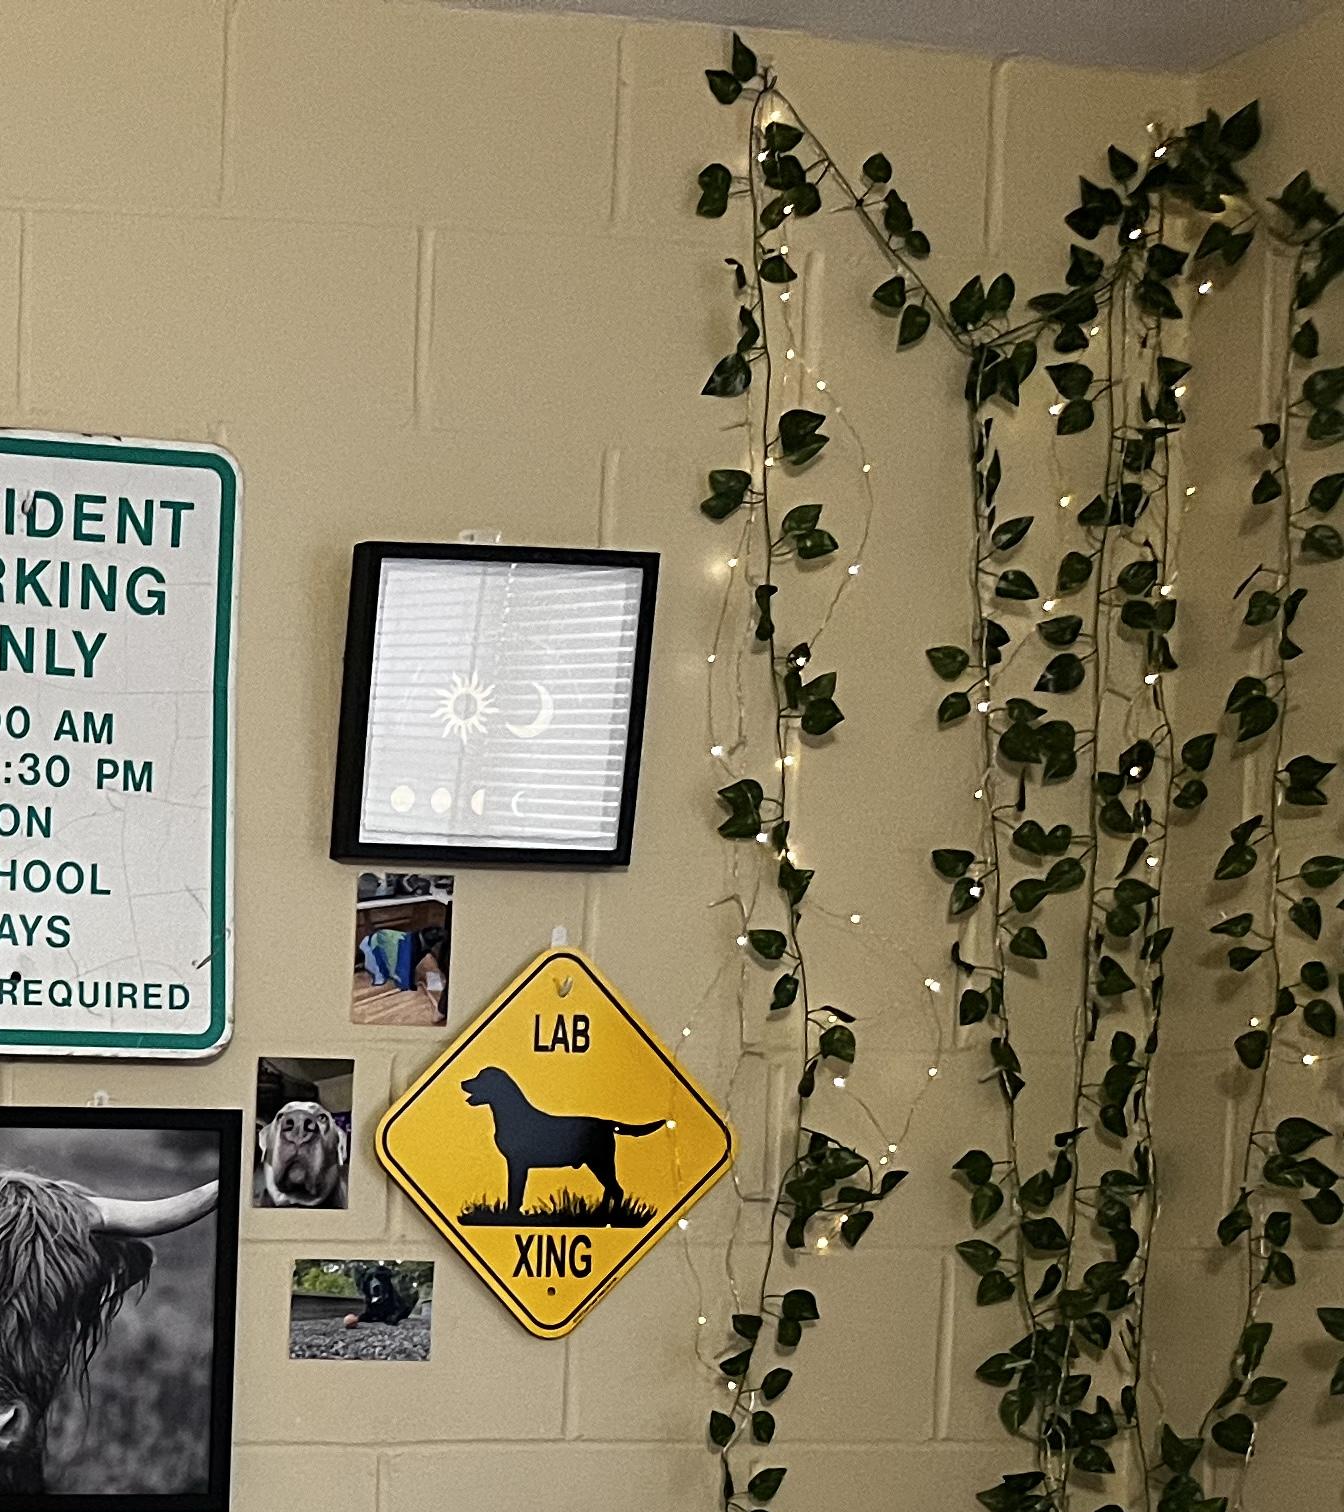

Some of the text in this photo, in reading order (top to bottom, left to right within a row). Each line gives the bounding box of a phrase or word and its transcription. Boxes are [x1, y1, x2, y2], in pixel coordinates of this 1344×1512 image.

[53, 709, 114, 745] AM
[96, 758, 153, 793] PM
[533, 1014, 590, 1054] LAB
[512, 1234, 592, 1279] XING
